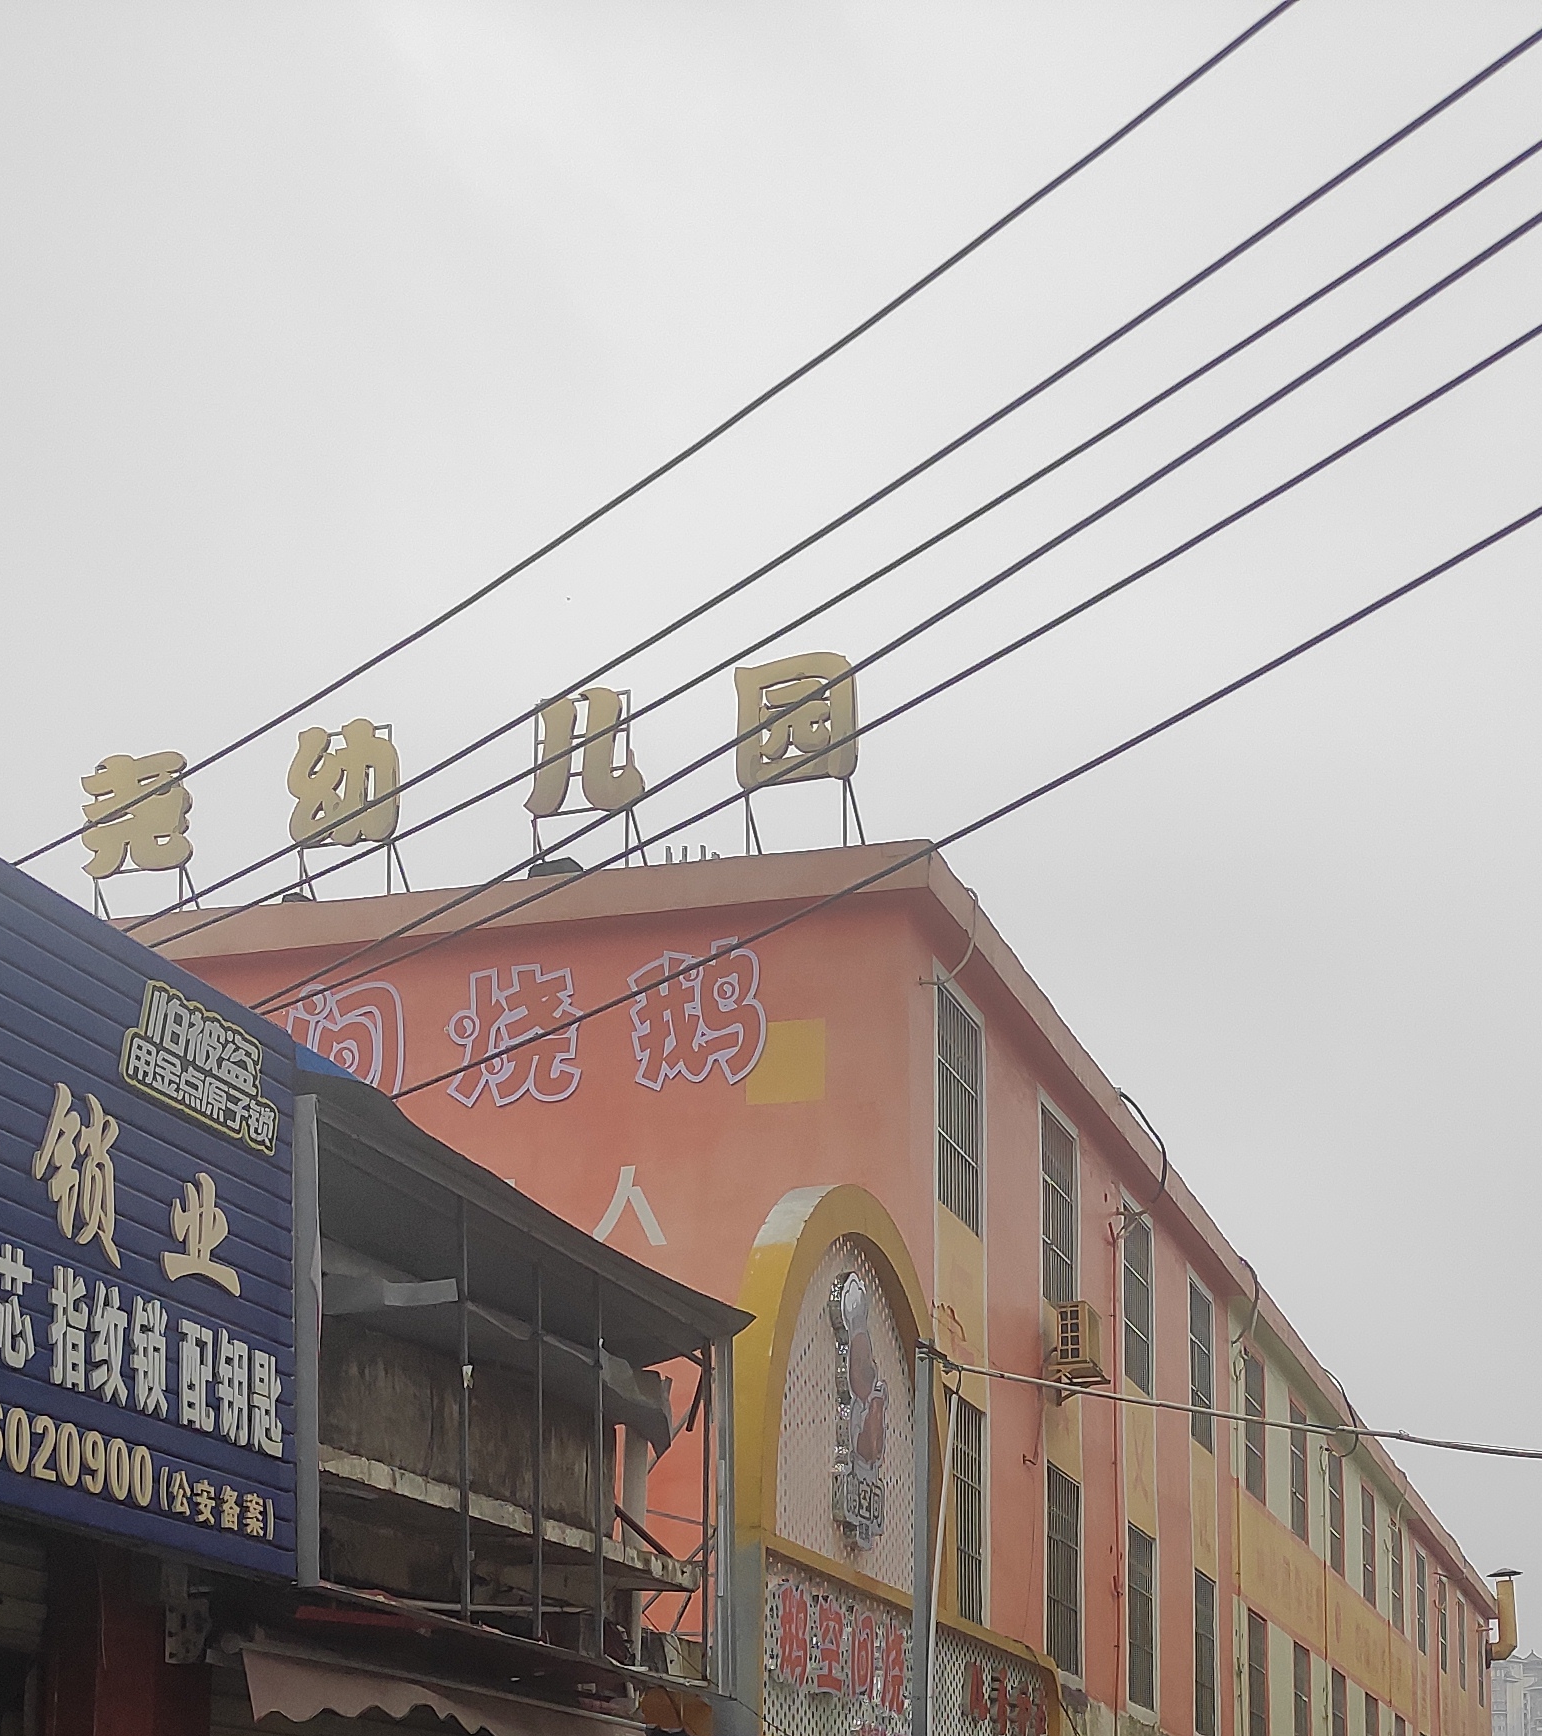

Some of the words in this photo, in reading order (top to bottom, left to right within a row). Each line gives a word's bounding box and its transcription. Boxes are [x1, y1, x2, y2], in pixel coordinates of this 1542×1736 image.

[127, 1036, 275, 1147] 用金点原子锁
[147, 990, 259, 1096] 怕被盗
[49, 1265, 168, 1419] 指纹锁
[178, 1318, 284, 1458] 配钥匙
[160, 1466, 275, 1541] (公安备案)
